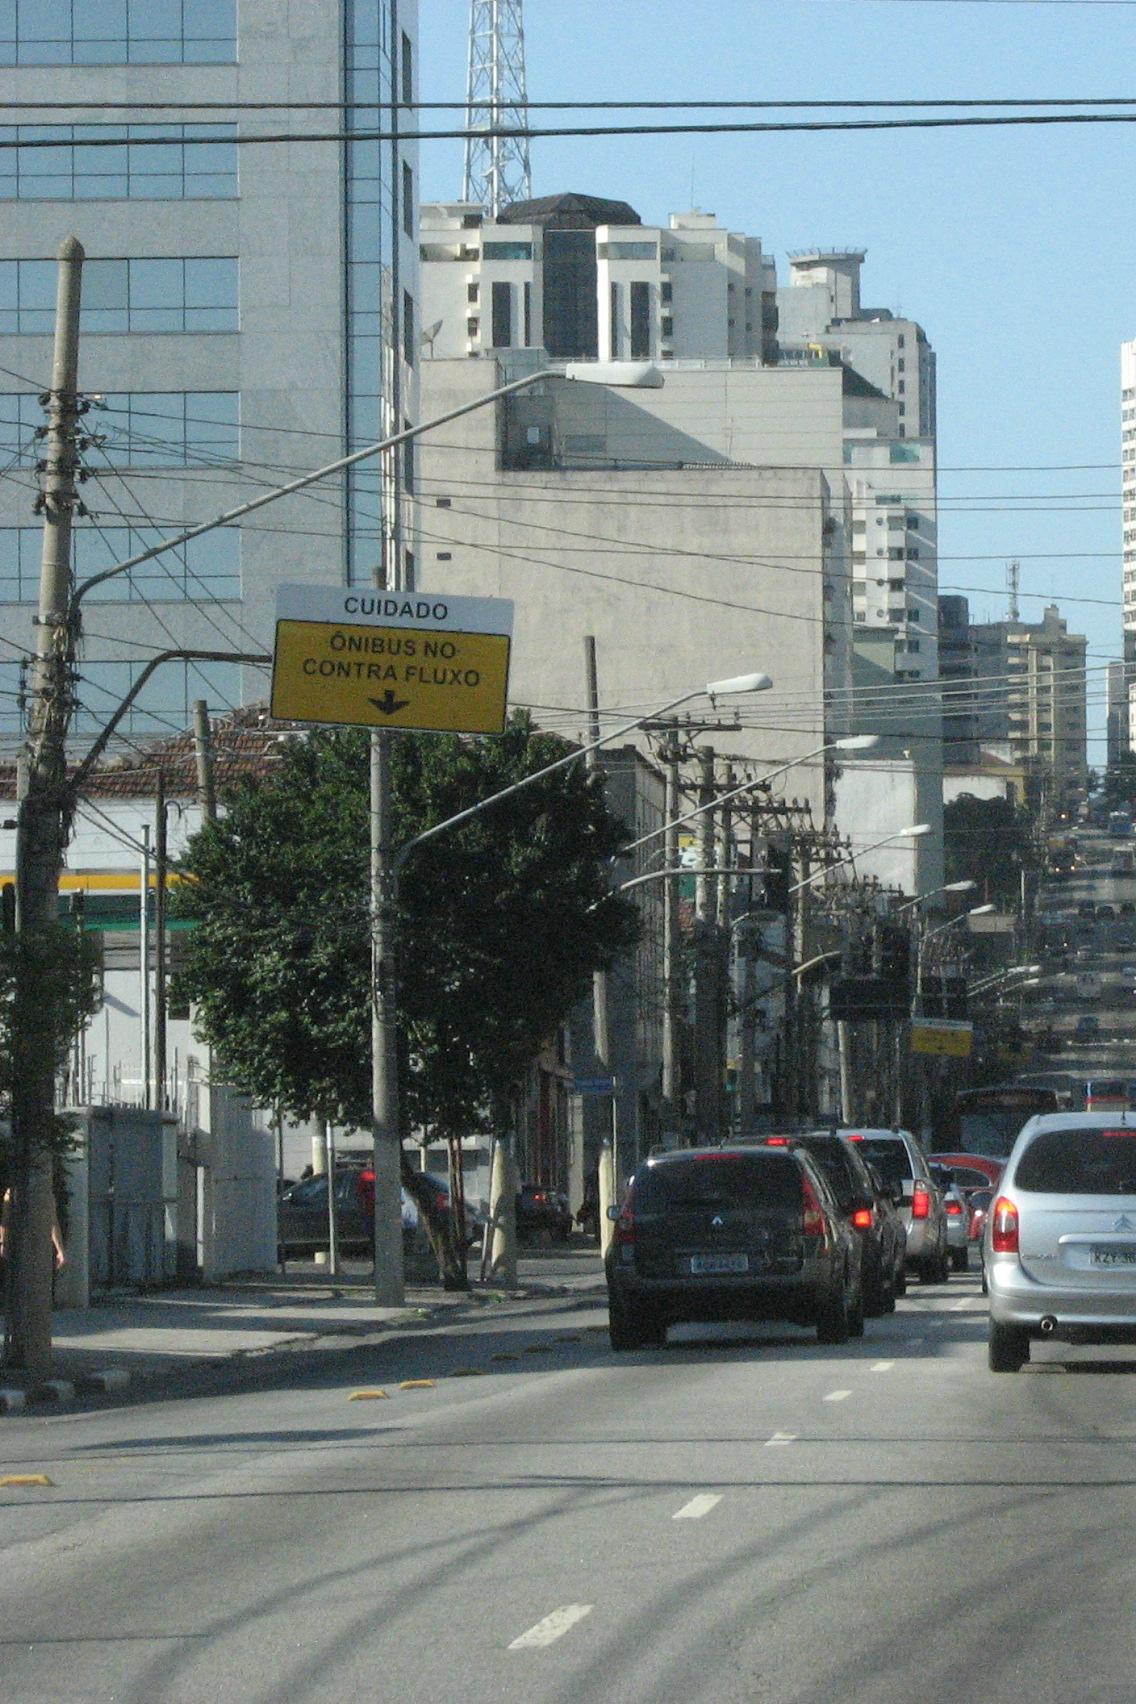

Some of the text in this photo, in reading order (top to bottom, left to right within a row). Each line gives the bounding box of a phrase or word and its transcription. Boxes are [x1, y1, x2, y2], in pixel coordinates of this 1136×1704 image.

[343, 596, 449, 621] CUIDADO
[329, 630, 457, 660] ÔNIBUS NO
[302, 657, 481, 687] CONTRA FLUXO
